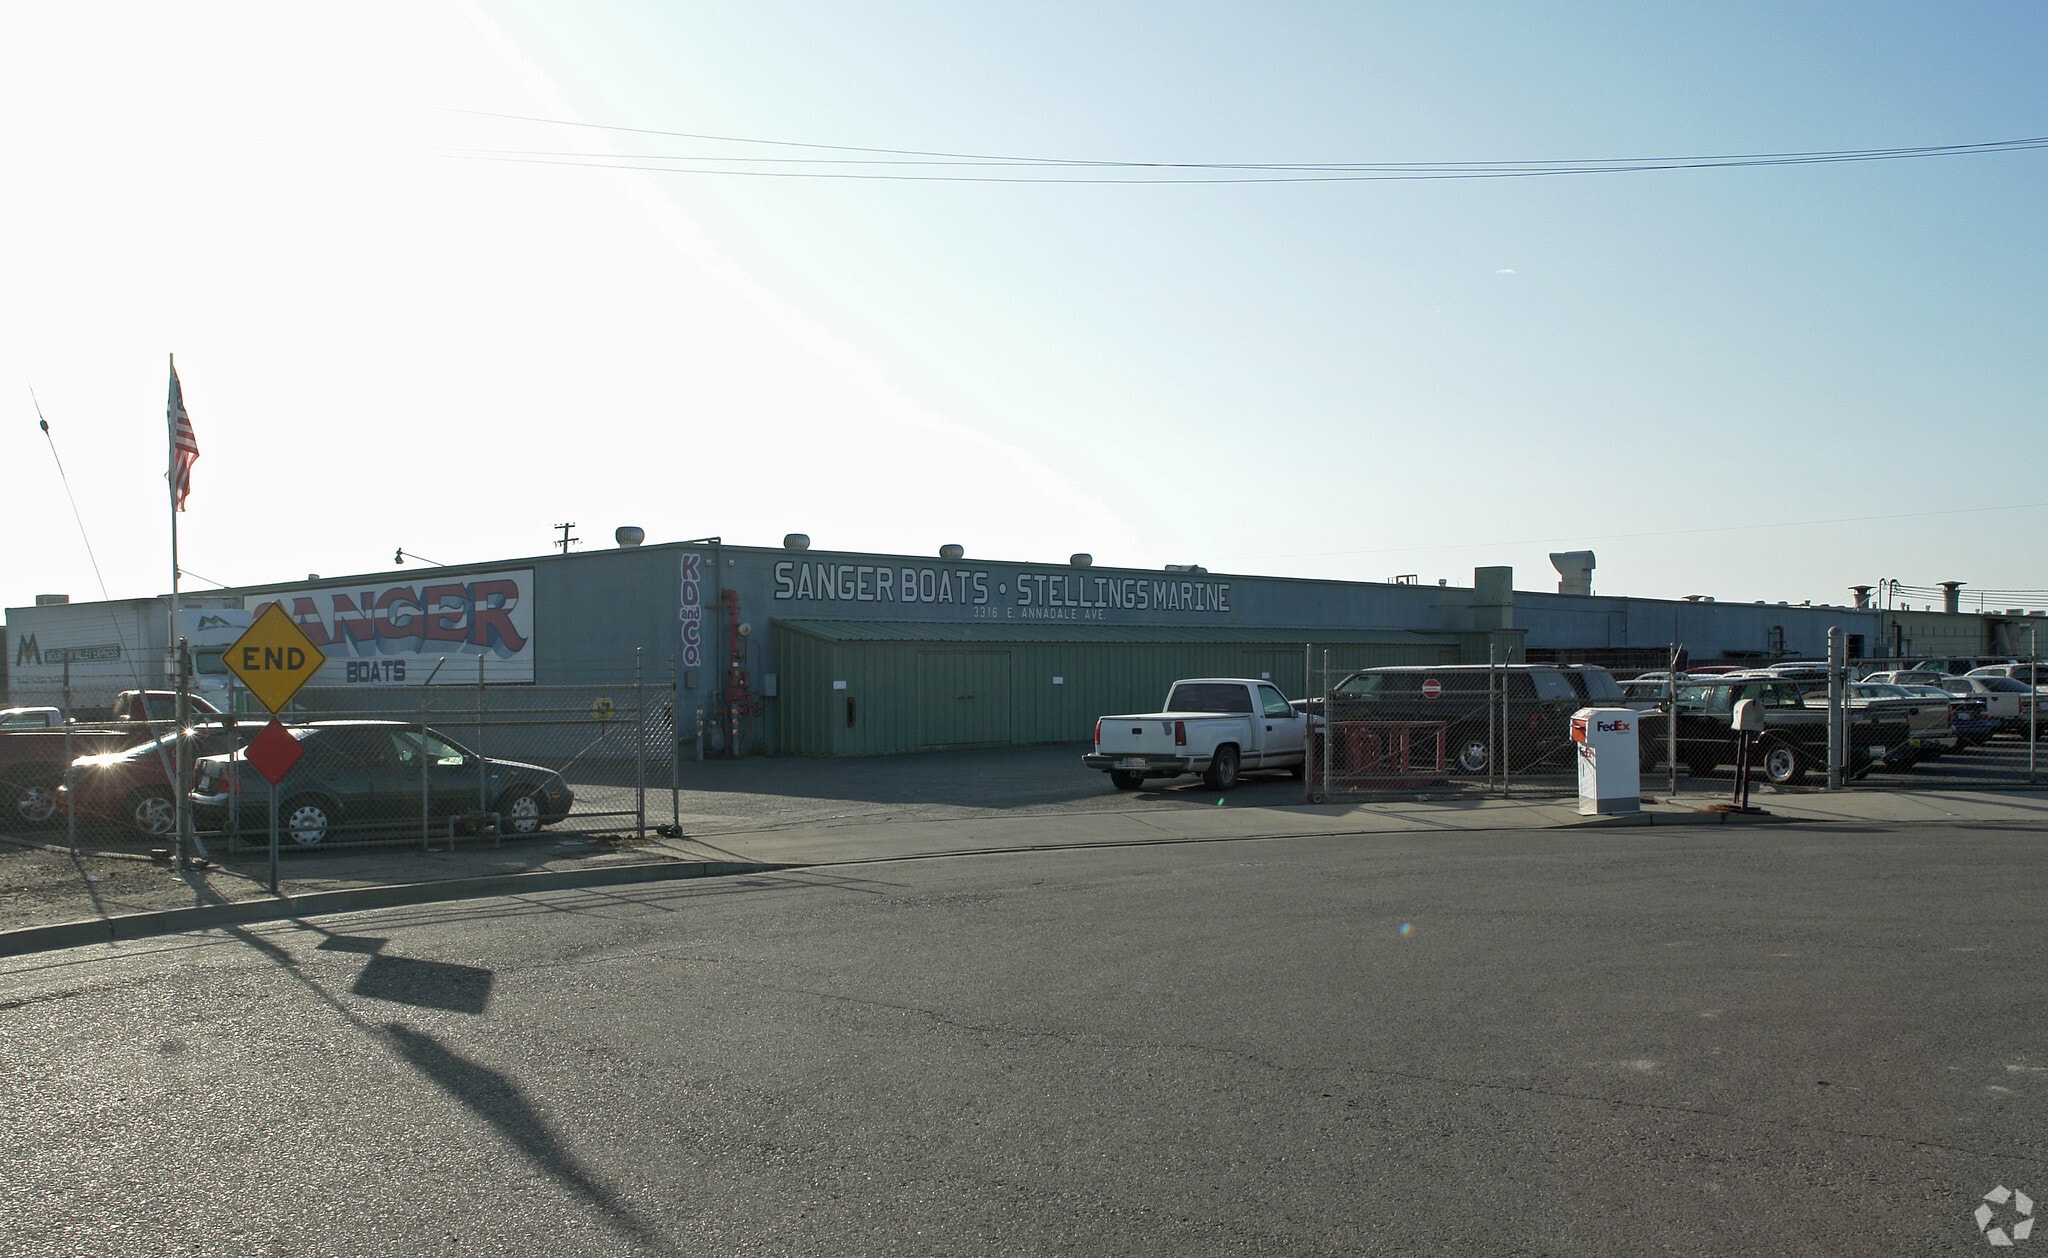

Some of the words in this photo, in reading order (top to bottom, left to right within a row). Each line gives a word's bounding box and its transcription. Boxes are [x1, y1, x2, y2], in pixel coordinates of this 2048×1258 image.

[774, 561, 895, 601] SANGER
[901, 567, 989, 605] BOATS
[1016, 573, 1149, 609] STELLINGS
[1153, 581, 1231, 612] MARINE
[973, 606, 998, 618] 3316
[1007, 607, 1016, 619] E.
[1021, 608, 1077, 620] ANNADALE
[1084, 609, 1106, 620] AVE.
[243, 647, 305, 670] END
[346, 659, 405, 682] BOATS
[1597, 720, 1630, 732] FedEx
